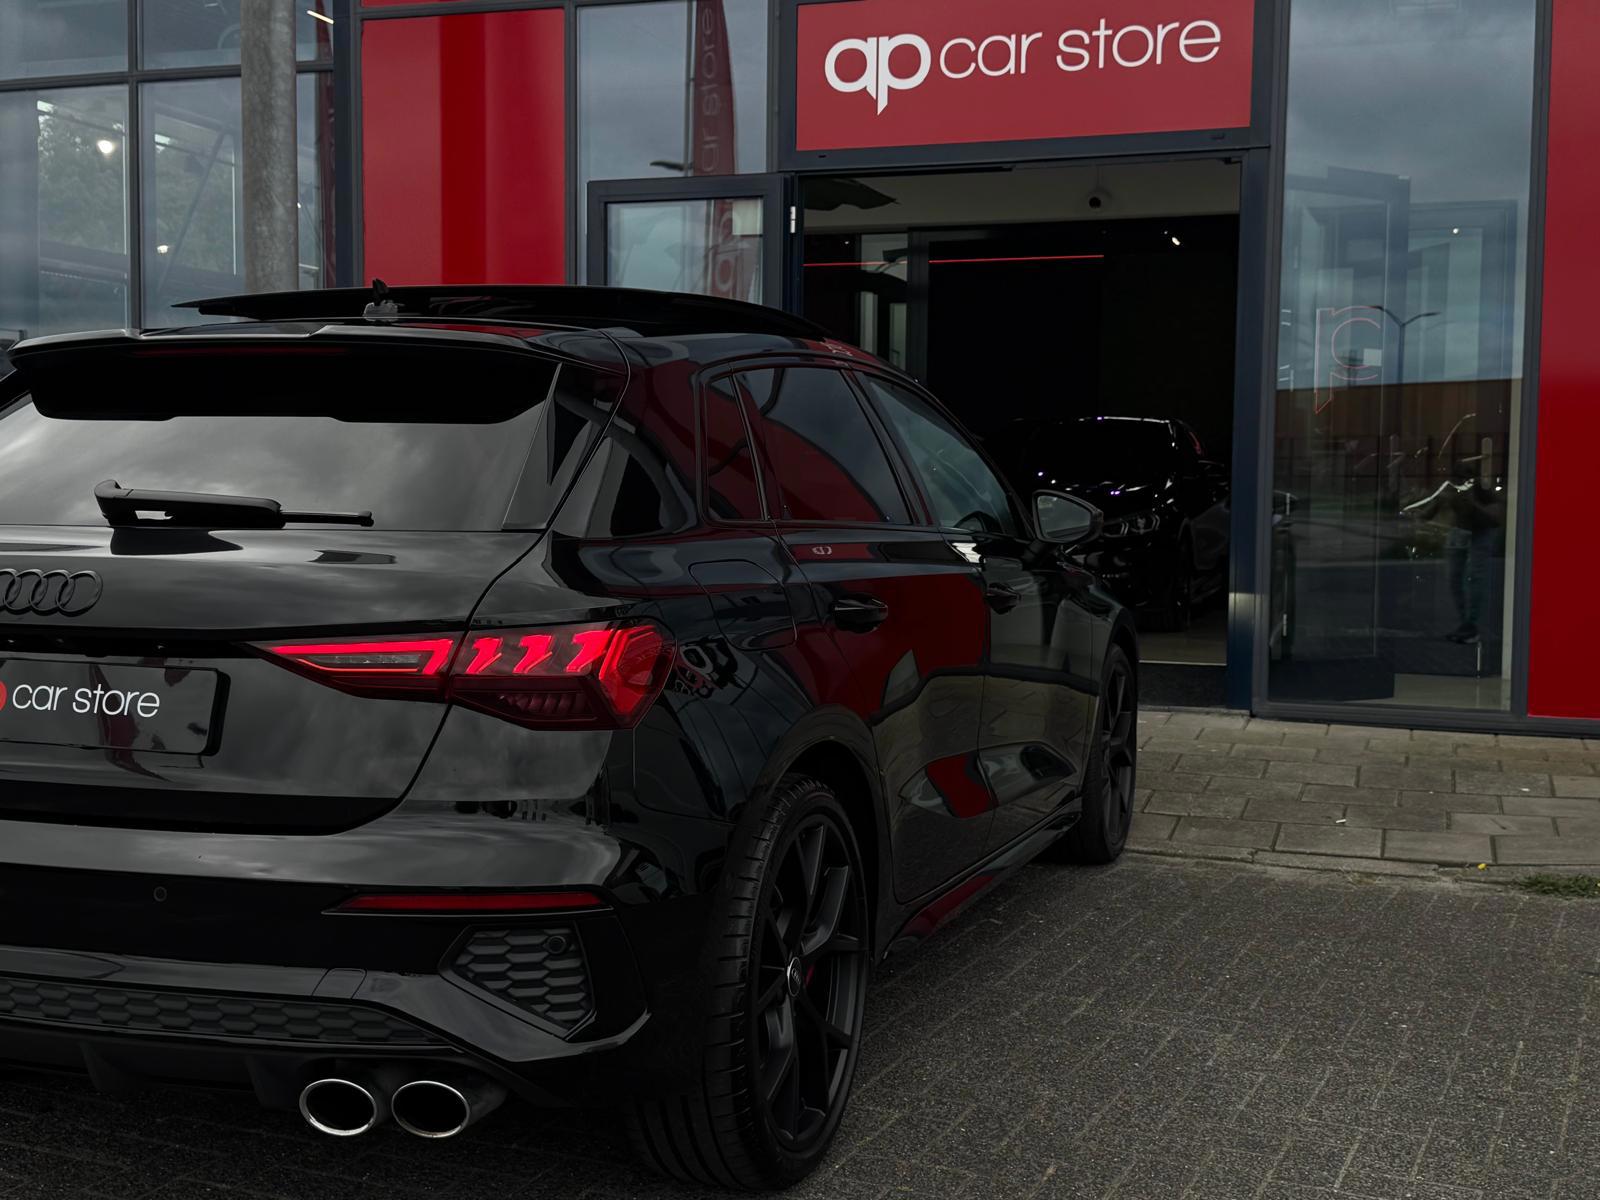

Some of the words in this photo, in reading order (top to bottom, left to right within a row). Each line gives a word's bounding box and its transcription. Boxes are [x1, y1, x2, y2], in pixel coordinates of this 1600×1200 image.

[824, 33, 932, 115] ap
[939, 31, 1042, 79] car
[1056, 18, 1221, 72] store
[12, 683, 68, 711] car
[72, 683, 160, 717] store
